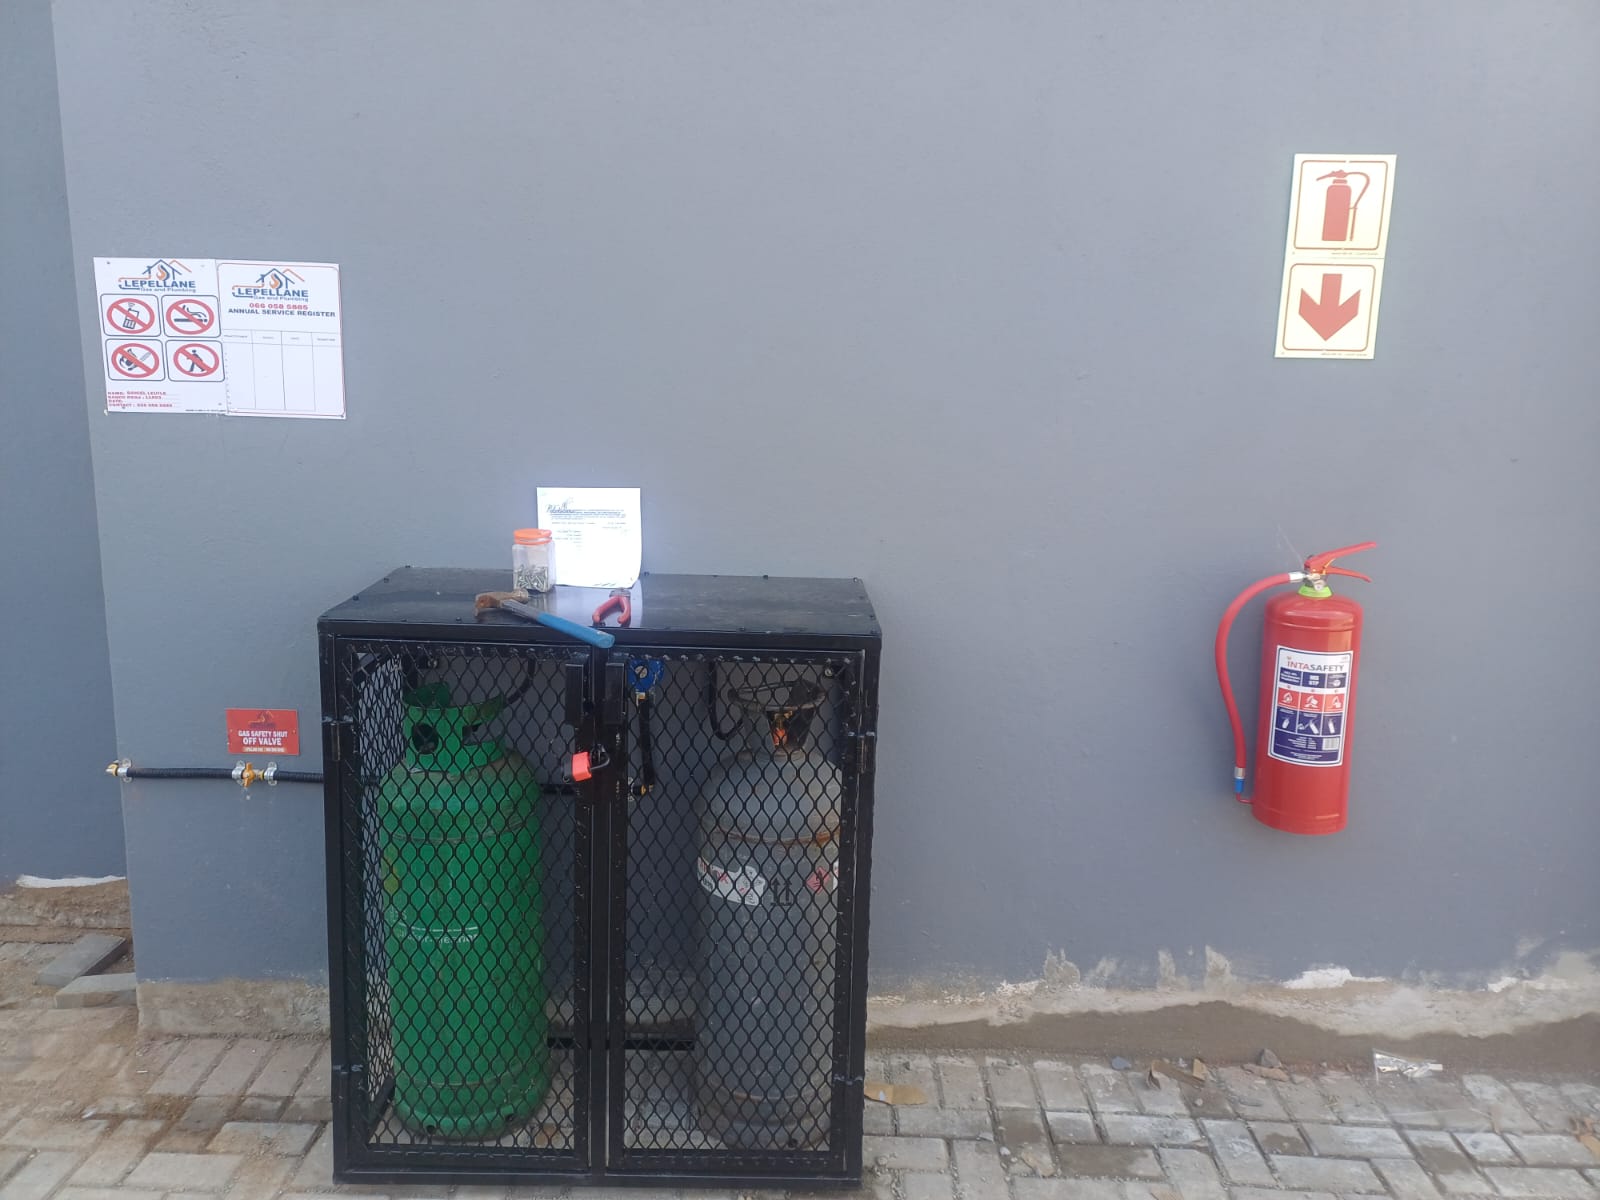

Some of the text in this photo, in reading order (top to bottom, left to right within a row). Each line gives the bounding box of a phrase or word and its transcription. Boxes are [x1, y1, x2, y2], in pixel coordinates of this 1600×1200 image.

[124, 280, 196, 288] LEPELLANE
[237, 288, 309, 297] LEPELLANE
[297, 310, 336, 318] REGISTER
[1287, 661, 1344, 672] INTASAFETY
[251, 730, 272, 738] SAFETY
[273, 730, 288, 738] SHUT
[242, 737, 282, 746] OFF VALVE
